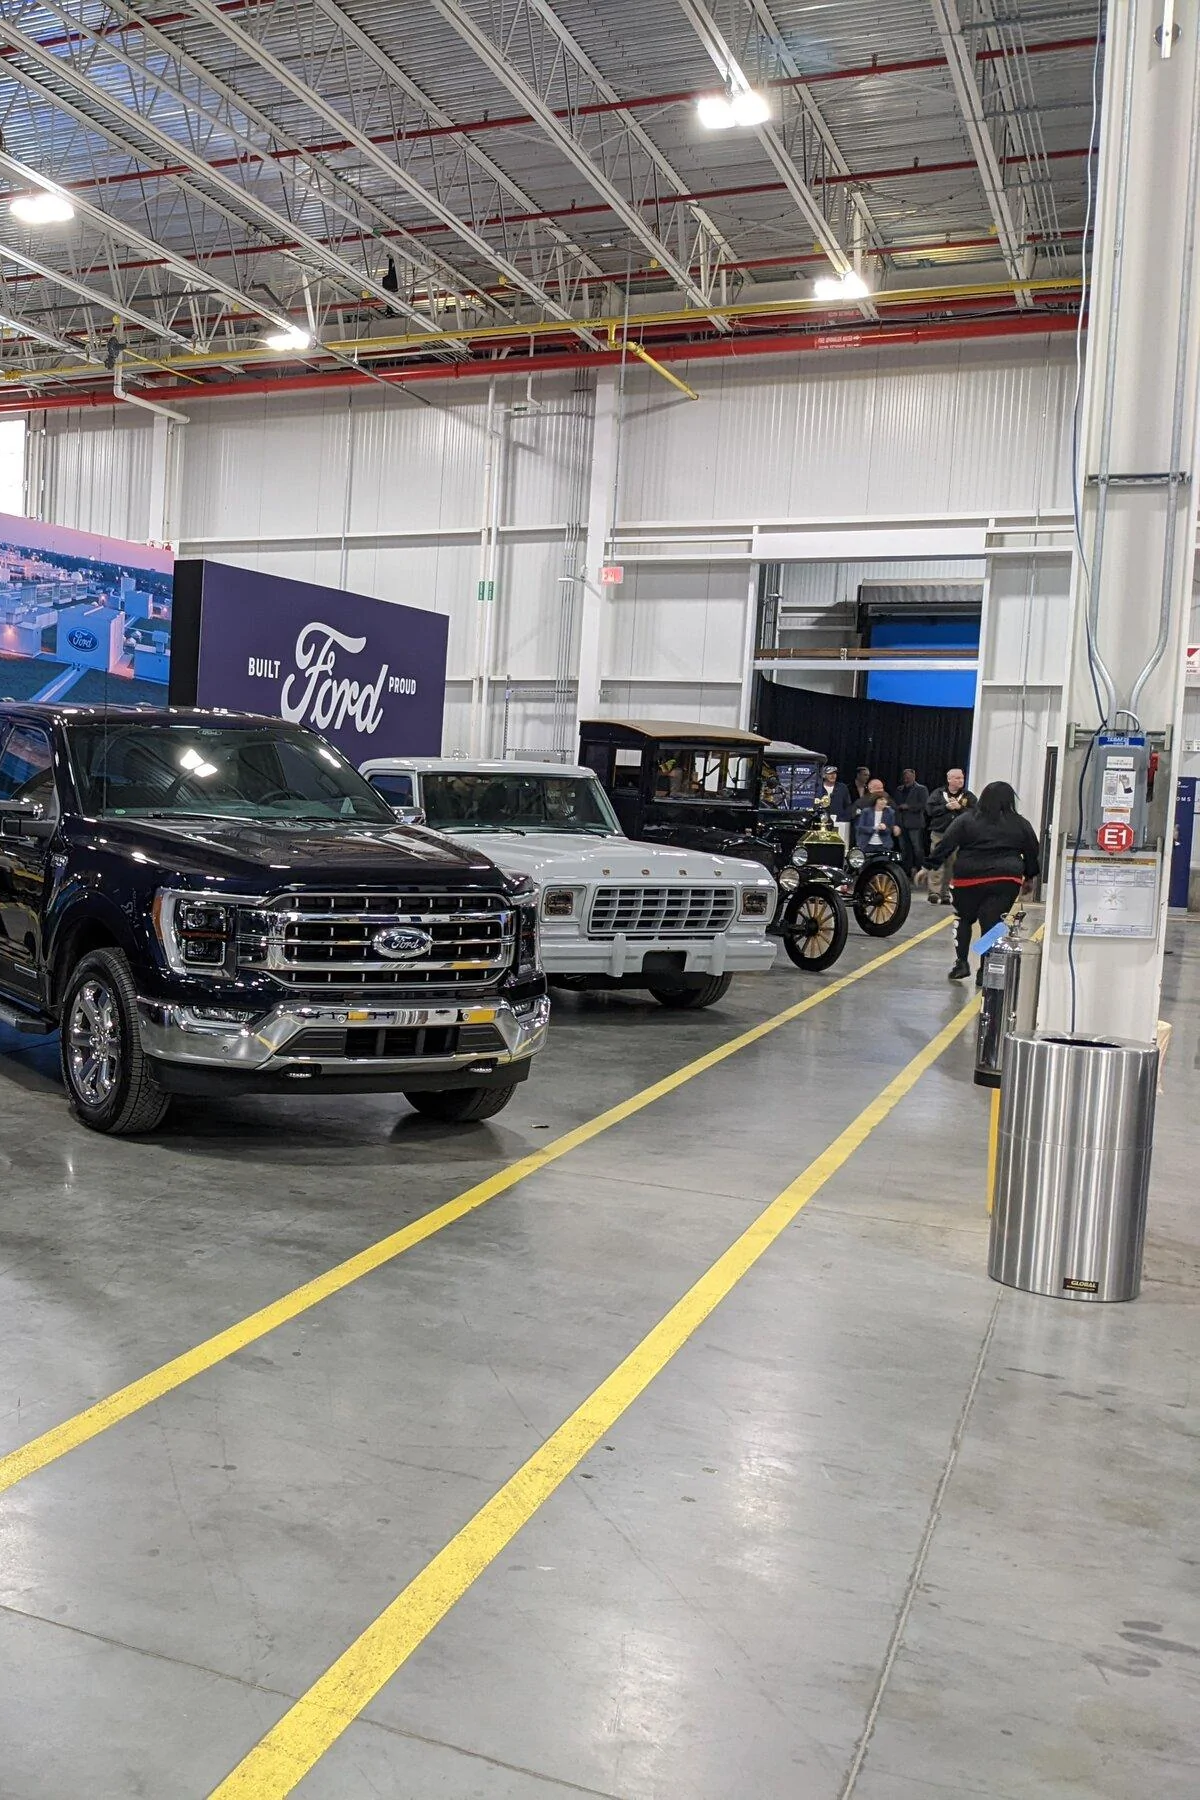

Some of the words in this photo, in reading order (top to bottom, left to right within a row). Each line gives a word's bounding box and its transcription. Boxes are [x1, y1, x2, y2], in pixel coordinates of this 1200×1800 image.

[72, 629, 94, 649] Ford
[248, 657, 281, 679] BUILT
[281, 621, 389, 734] Ford
[388, 676, 417, 695] PROUD
[1104, 828, 1128, 846] E1
[391, 935, 420, 949] Ford
